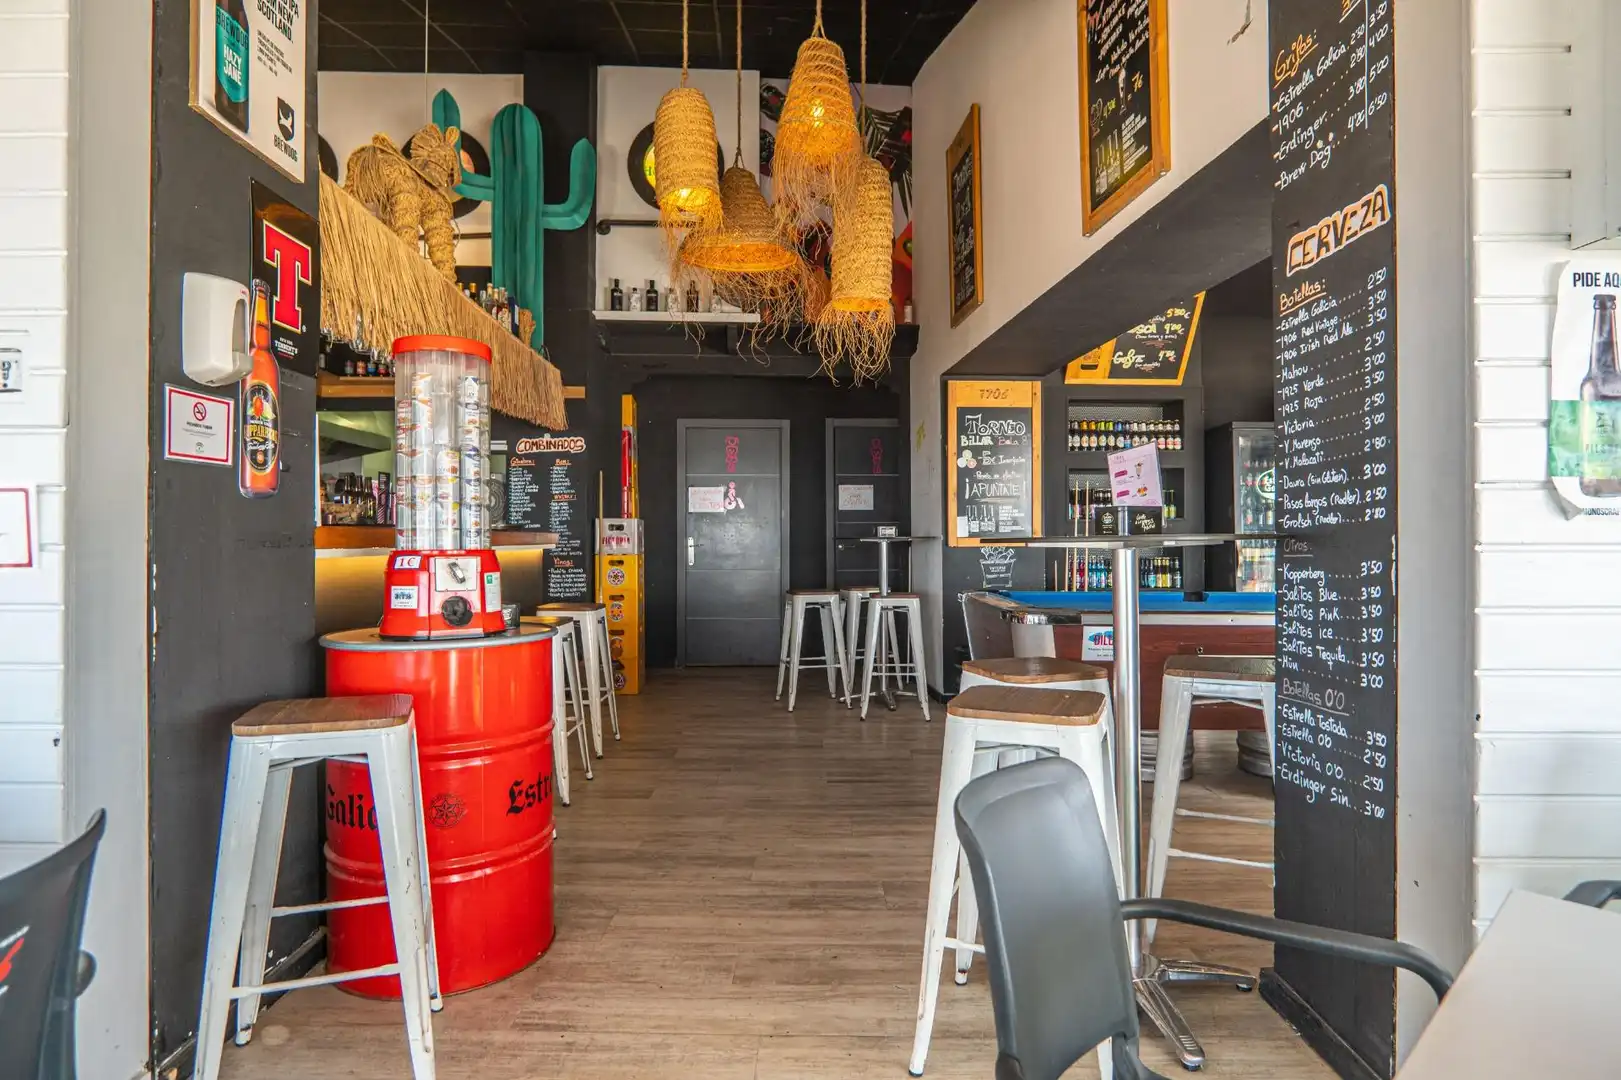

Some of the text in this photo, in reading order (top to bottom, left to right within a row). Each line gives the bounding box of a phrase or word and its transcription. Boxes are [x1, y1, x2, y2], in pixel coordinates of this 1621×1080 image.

[224, 43, 241, 70] HAZY
[224, 59, 242, 87] JANE
[1368, 92, 1388, 115] 6'50
[1280, 162, 1307, 191] Brew
[1287, 188, 1387, 274] CERVEZA
[263, 219, 312, 334] T
[1367, 267, 1387, 290] 2'50
[1573, 272, 1621, 288] PIDE AQ
[1301, 322, 1315, 338] Red
[1368, 289, 1387, 311] 3'50
[1324, 329, 1339, 345] Red
[1367, 307, 1387, 328] 3'50
[1364, 330, 1385, 352] 2'50
[1282, 384, 1299, 400] 1925
[1364, 352, 1386, 372] 3'00
[1282, 400, 1300, 417] 1925
[1364, 370, 1385, 389] 3'50
[1364, 412, 1385, 430] 3'00
[517, 438, 585, 453] COMBINADOS
[1363, 463, 1387, 480] 3'00
[1365, 486, 1387, 503] 2'50
[1361, 560, 1383, 577] 3'50
[1319, 588, 1339, 602] Blue
[1361, 586, 1382, 600] 3'50
[1361, 604, 1383, 619] 3'50
[1361, 628, 1384, 643] 3'50
[1315, 645, 1346, 671] Tequila
[1360, 651, 1385, 668] 3'50
[1366, 730, 1387, 748] 3'50
[1281, 741, 1322, 773] Victoria
[1363, 775, 1384, 792] 2'50
[1363, 748, 1387, 769] 2'50
[1281, 763, 1326, 803] Erdinger
[1363, 800, 1385, 819] 3'00
